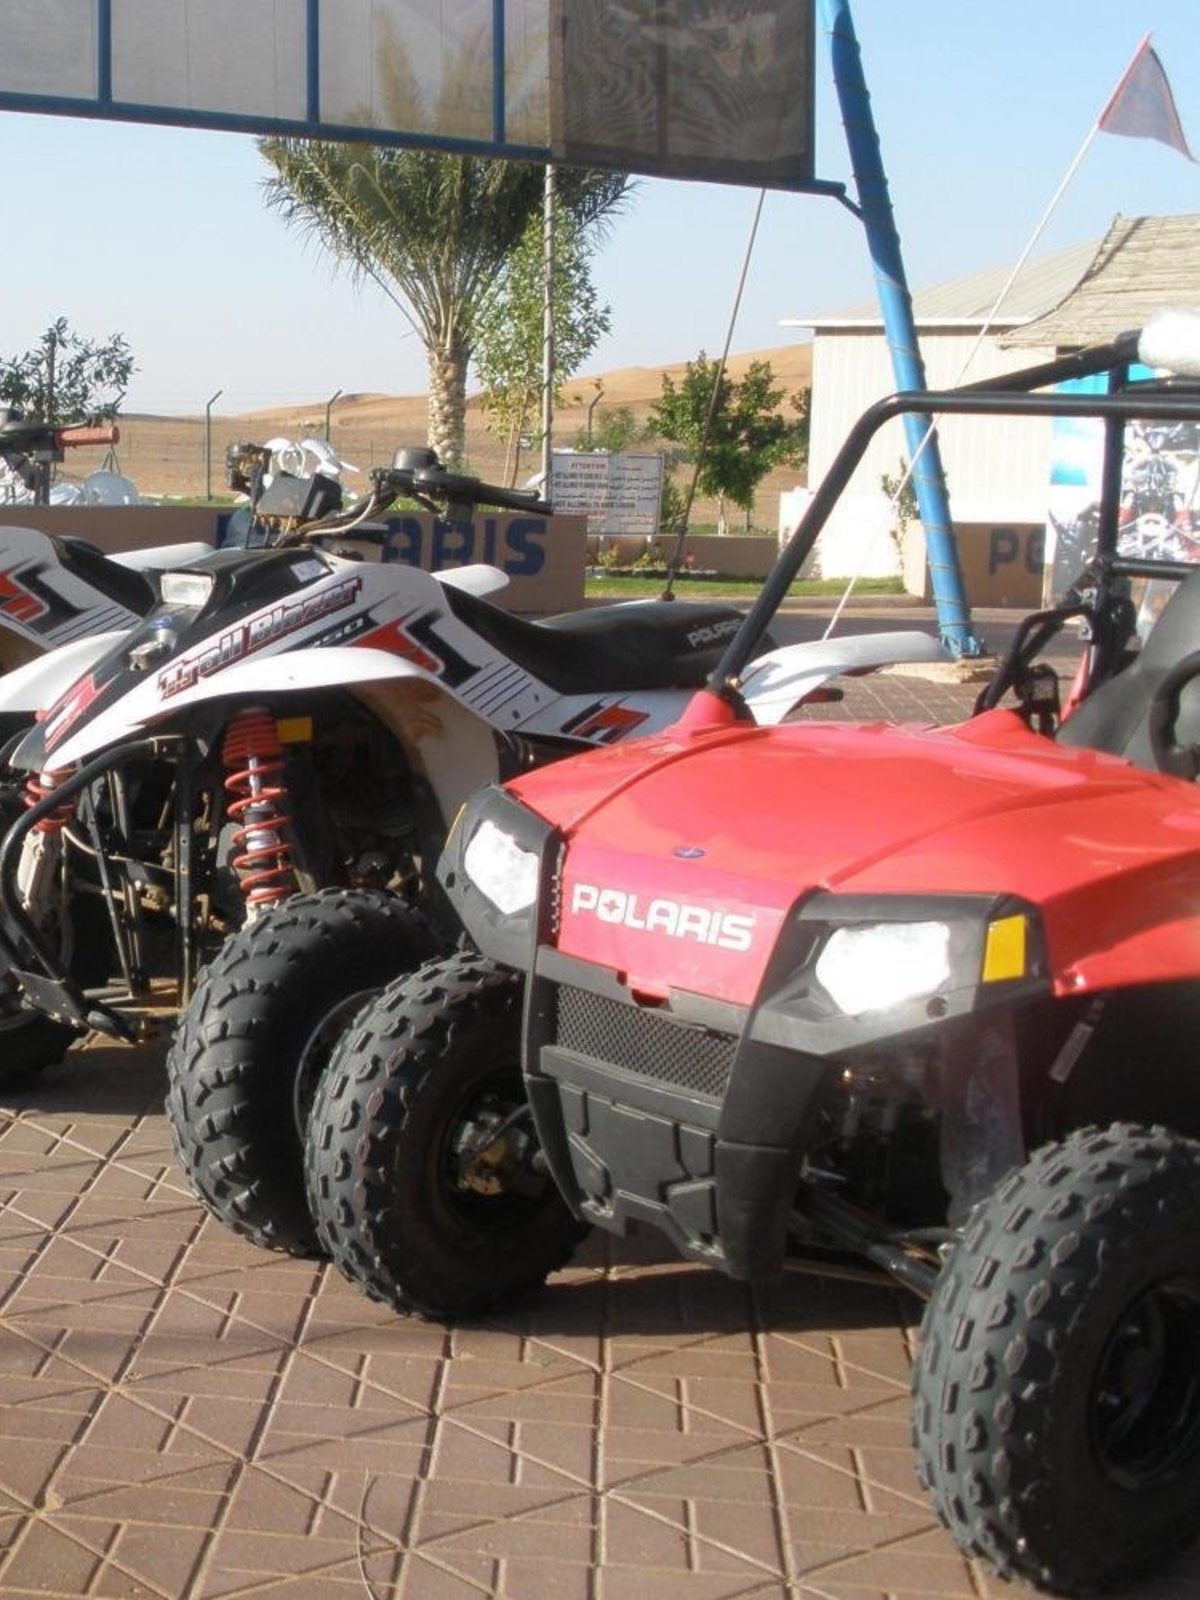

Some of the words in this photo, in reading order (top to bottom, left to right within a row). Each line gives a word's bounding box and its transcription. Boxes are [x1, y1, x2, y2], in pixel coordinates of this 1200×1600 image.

[158, 625, 248, 701] Trail
[246, 575, 363, 650] Blazer
[570, 882, 756, 952] POLARIS
